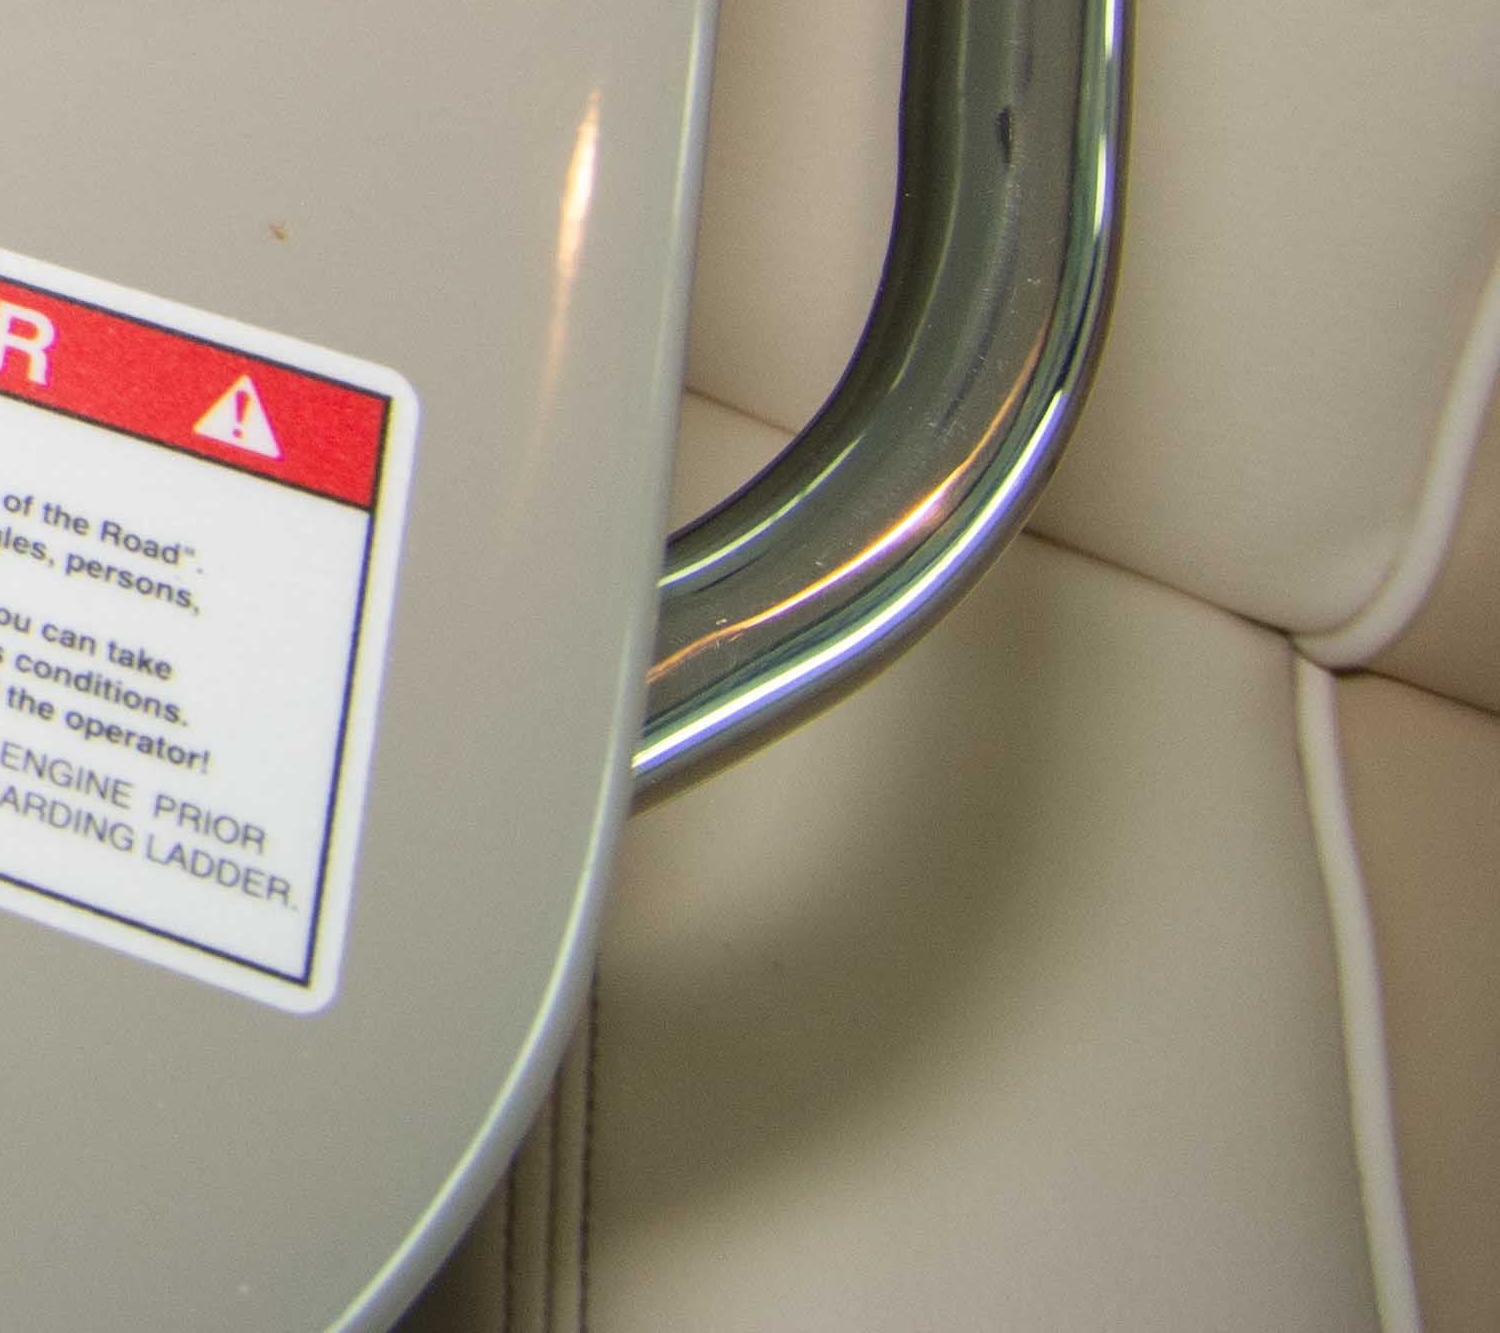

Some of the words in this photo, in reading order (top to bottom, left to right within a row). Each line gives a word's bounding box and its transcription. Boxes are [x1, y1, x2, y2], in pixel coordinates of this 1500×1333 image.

[3, 494, 35, 517] of
[43, 504, 90, 536] the
[65, 553, 200, 616] persons,
[15, 654, 188, 727] conditions.
[1, 741, 133, 810] ENGINE
[154, 793, 266, 855] PRIOR
[146, 834, 297, 910] LADDER.
